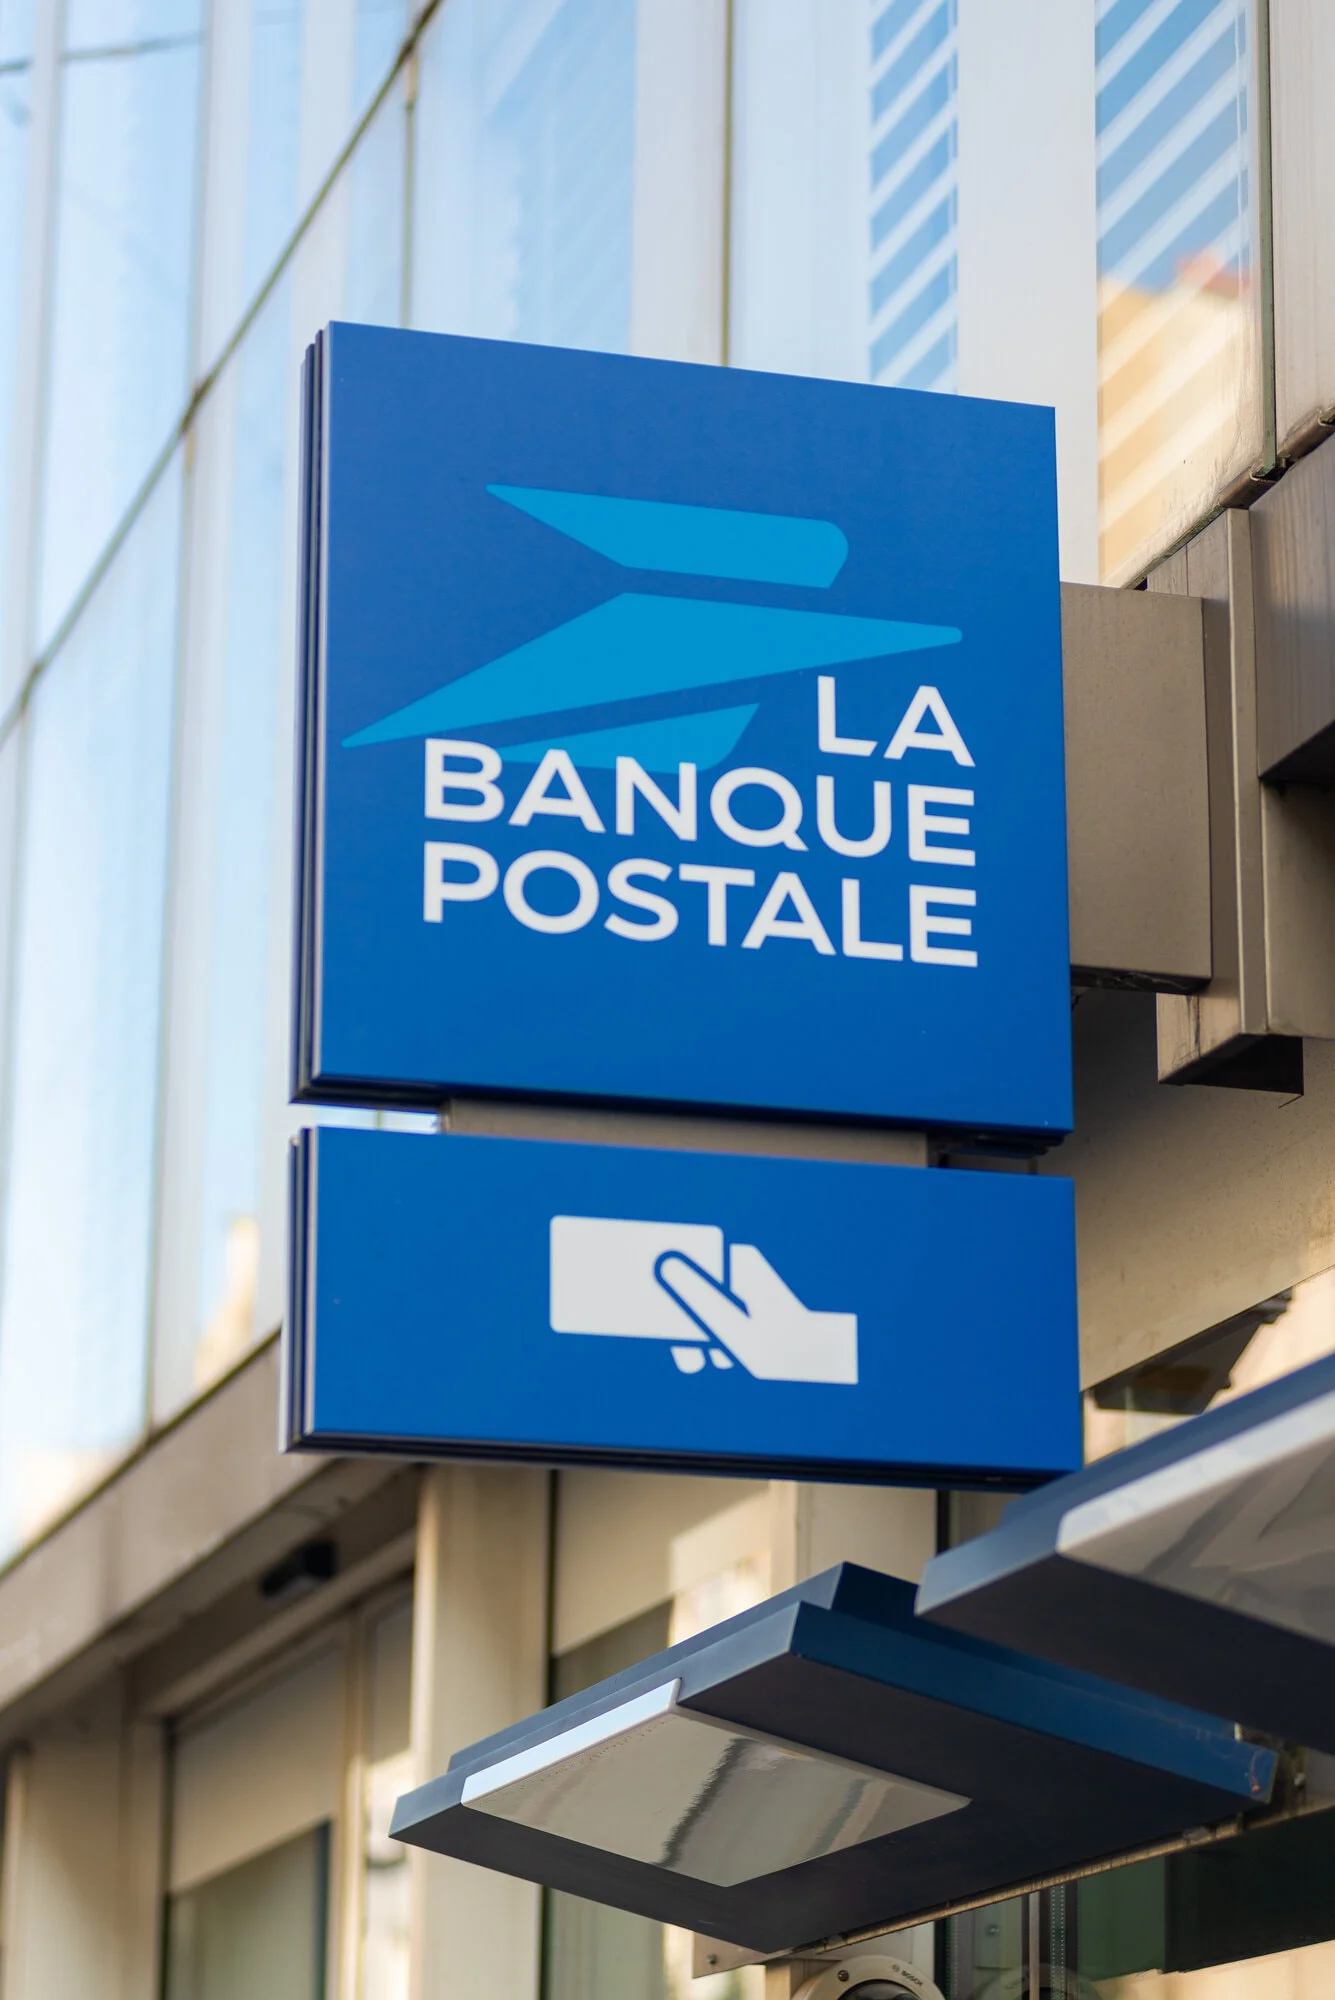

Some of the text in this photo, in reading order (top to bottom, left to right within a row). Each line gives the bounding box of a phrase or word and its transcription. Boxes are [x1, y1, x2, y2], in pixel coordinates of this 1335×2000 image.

[817, 675, 976, 767] LA
[424, 738, 976, 867] BANQUE
[423, 841, 978, 967] POSTALE
